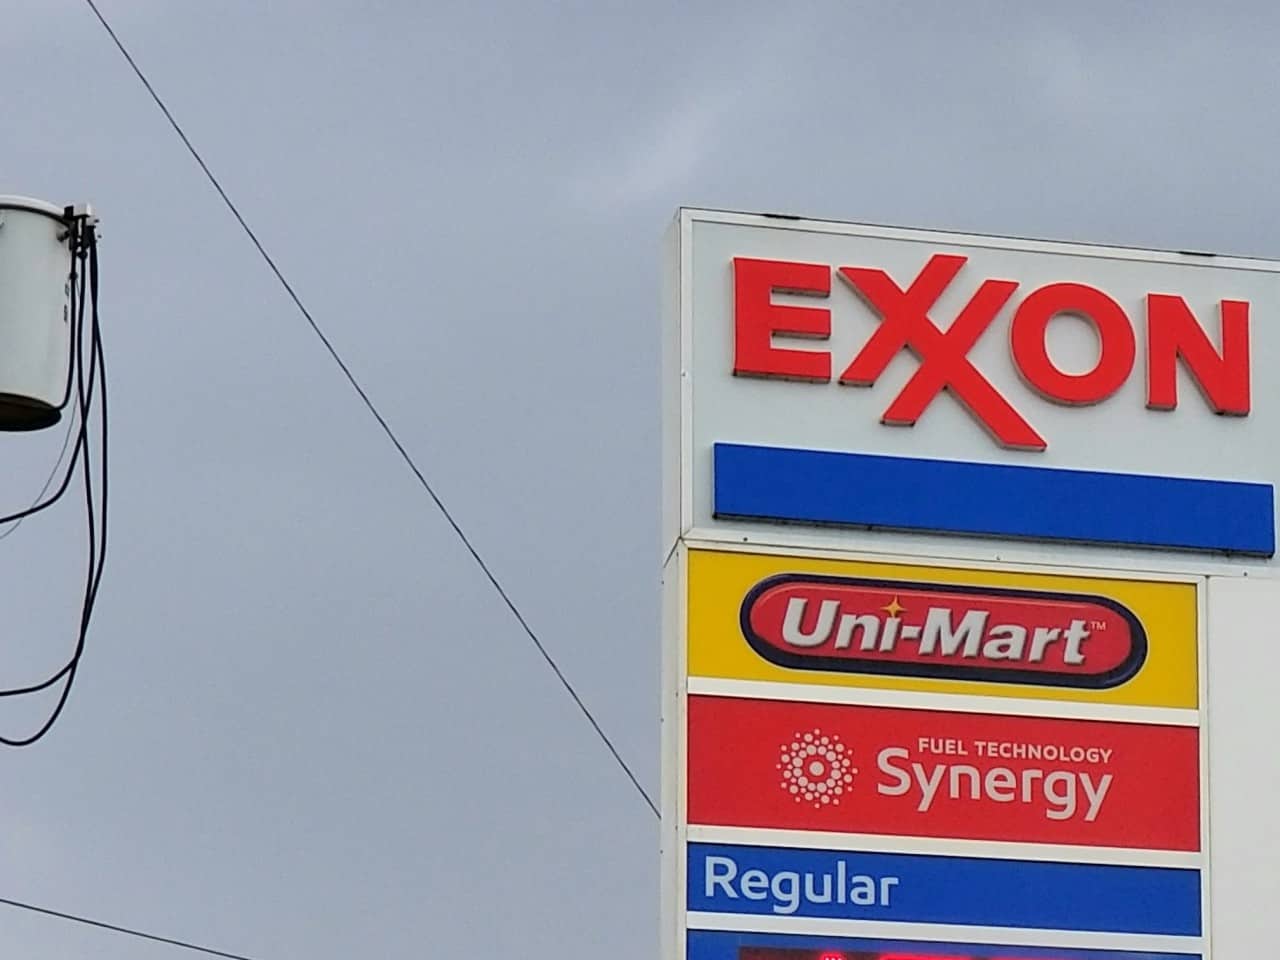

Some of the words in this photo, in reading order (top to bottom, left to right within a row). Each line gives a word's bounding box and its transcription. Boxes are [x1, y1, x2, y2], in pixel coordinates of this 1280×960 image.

[733, 254, 1250, 452] EXXON
[782, 597, 1090, 665] Uni-Mart
[876, 747, 1114, 821] Synergy
[918, 737, 968, 757] FUEL
[974, 740, 1113, 764] TECHNOLOGY
[704, 856, 899, 914] Regular
